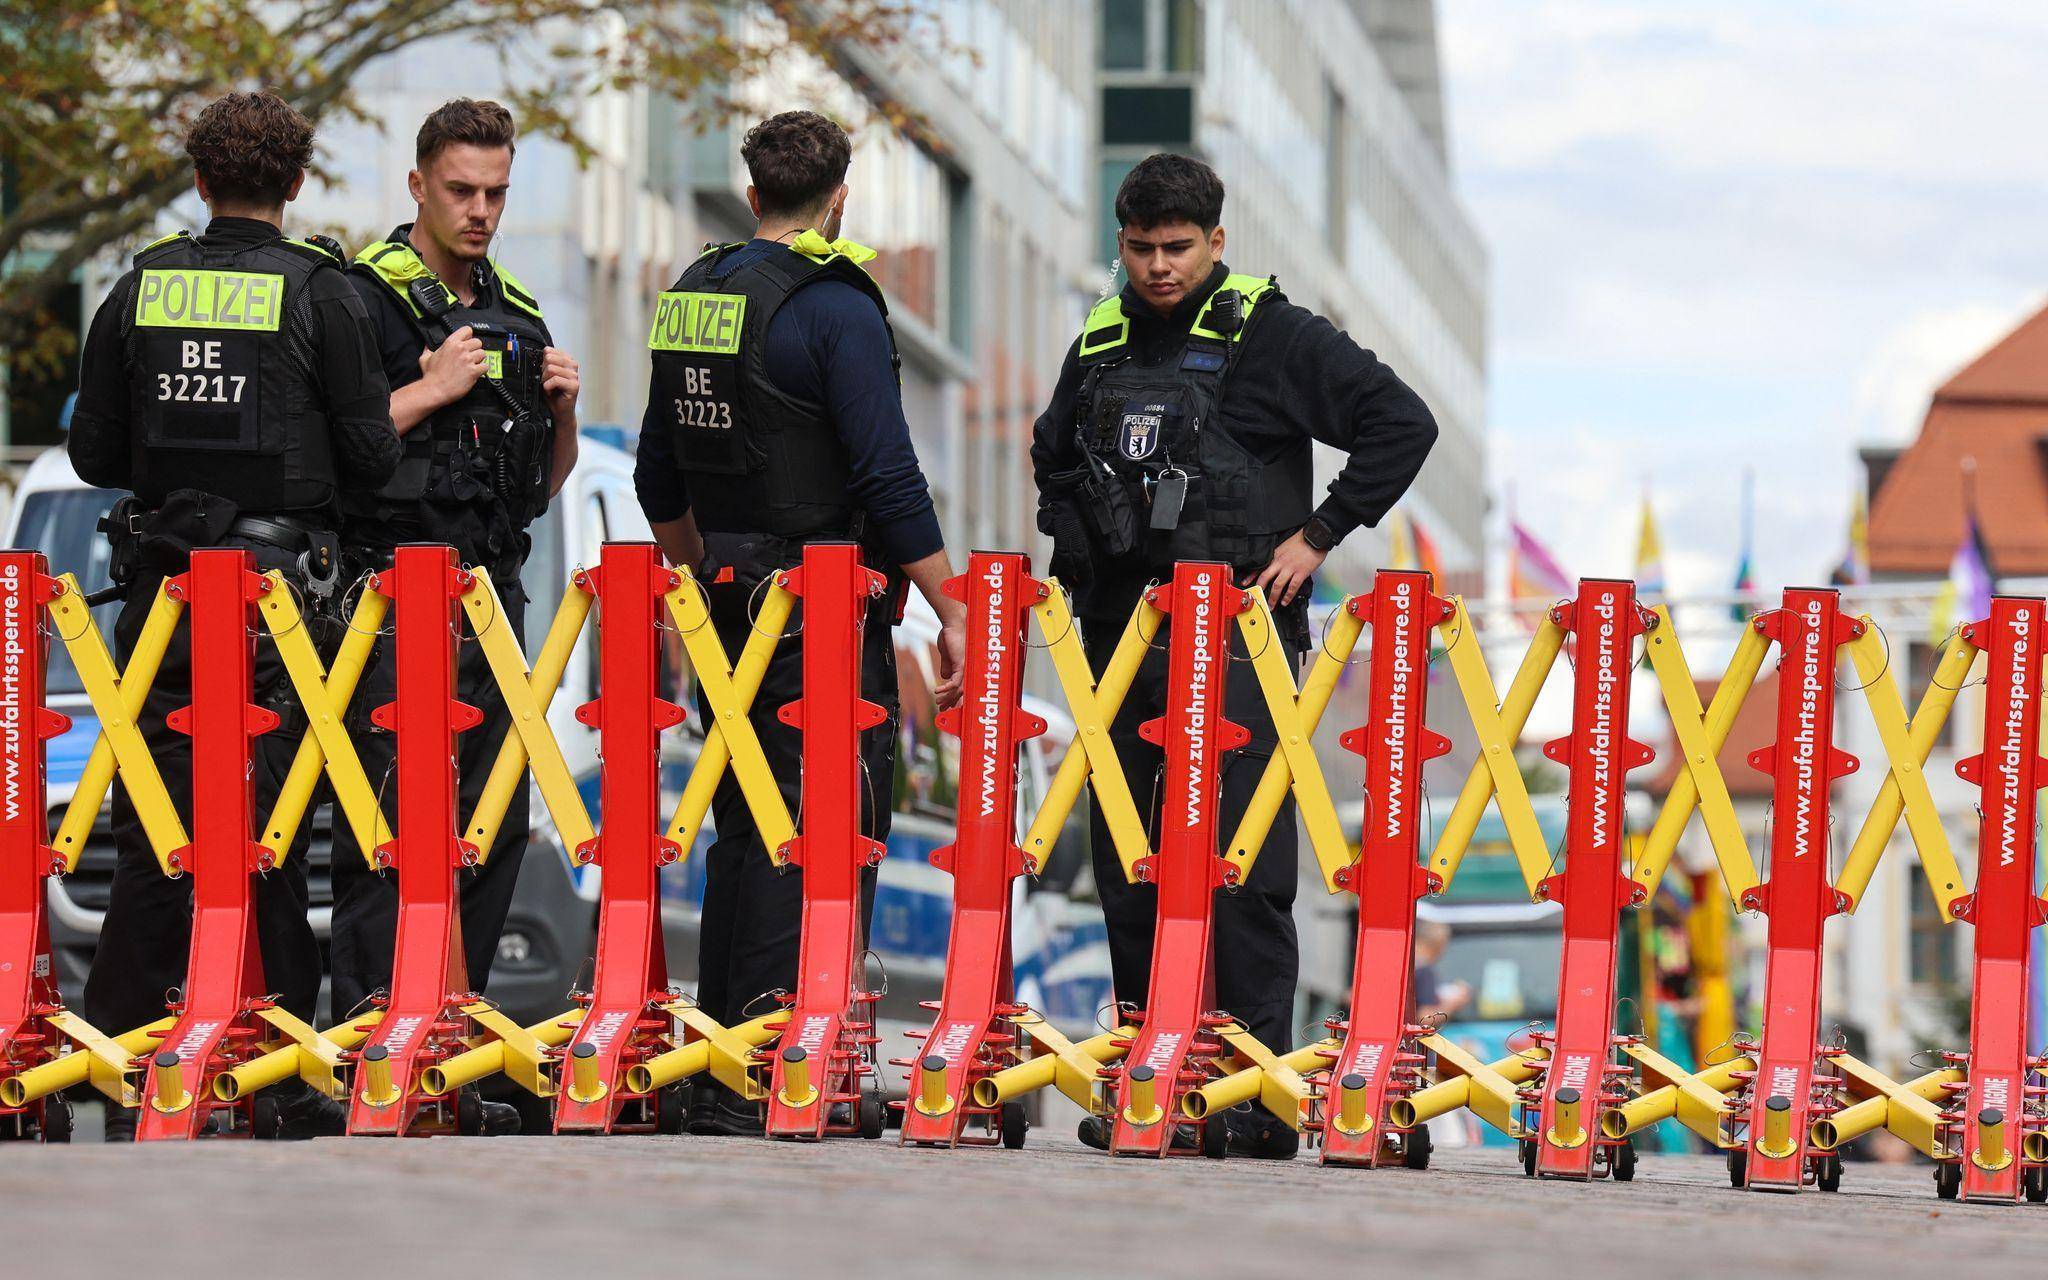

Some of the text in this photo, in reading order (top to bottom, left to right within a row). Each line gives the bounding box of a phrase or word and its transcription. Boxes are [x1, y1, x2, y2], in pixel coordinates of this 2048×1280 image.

[138, 274, 279, 326] POLIZEI
[653, 298, 742, 348] POLIZEI
[181, 340, 222, 369] BE
[685, 366, 713, 395] BE
[157, 373, 247, 403] 32217
[674, 398, 733, 429] 32223
[1125, 416, 1159, 426] POLIZEI
[978, 561, 1006, 817] www.zufahrtssperre.de
[1184, 572, 1213, 827] www.zufahrtssperre.de
[1384, 582, 1413, 838] www.zufahrtssperre.de
[1589, 592, 1617, 849] www.zufahrtssperre.de
[1792, 600, 1822, 858] www.zufahrtssperre.de
[1998, 608, 2030, 867] www.zufahrtssperre.de
